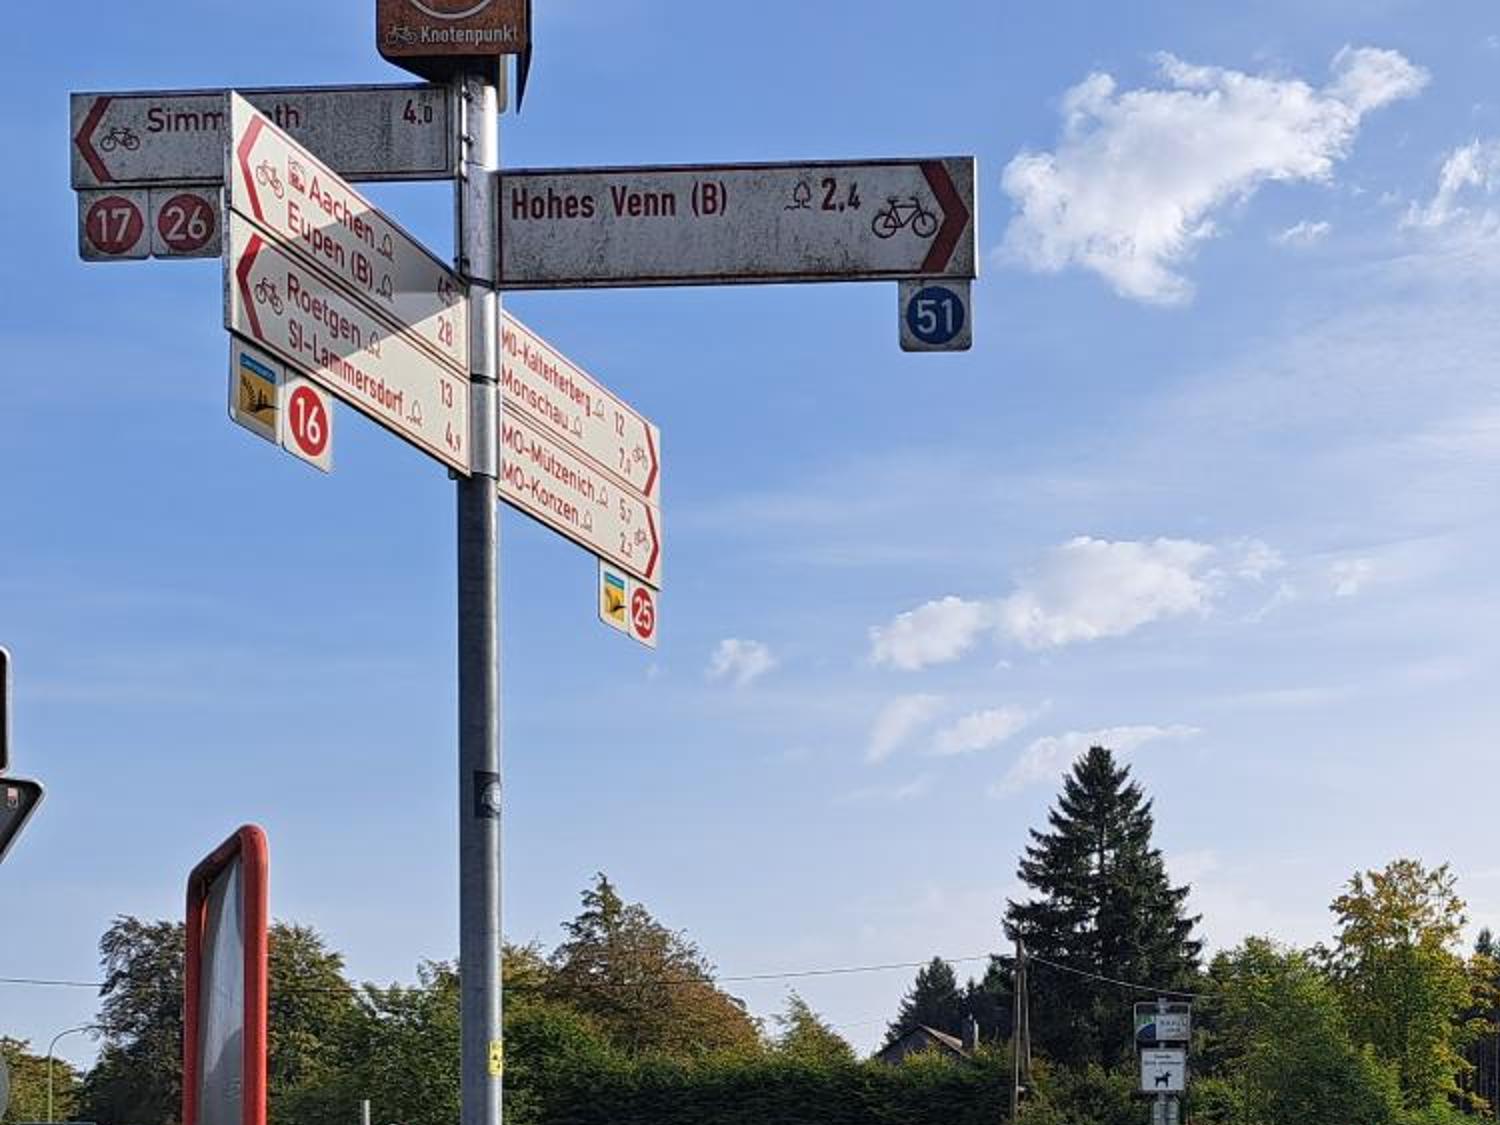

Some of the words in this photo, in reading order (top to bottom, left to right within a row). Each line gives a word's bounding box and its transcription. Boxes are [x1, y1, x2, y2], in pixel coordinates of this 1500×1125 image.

[420, 24, 517, 46] Knotenpunkt
[147, 103, 300, 133] Simmth
[308, 175, 375, 249] Aachen
[511, 187, 595, 220] Hohes
[610, 184, 676, 217] Venn
[691, 180, 727, 217] (B)
[821, 177, 861, 212] 2,4
[96, 207, 132, 242] 17
[166, 205, 207, 239] 26
[288, 200, 345, 269] Eupen
[352, 250, 374, 292] (B)
[917, 299, 953, 333] 51
[287, 272, 361, 352] Roetgen
[440, 379, 453, 408] 13
[501, 363, 568, 432] Monschau
[296, 397, 321, 445] 16
[614, 411, 625, 437] 12
[501, 457, 579, 528] MO-Konzen
[634, 595, 653, 631] 25
